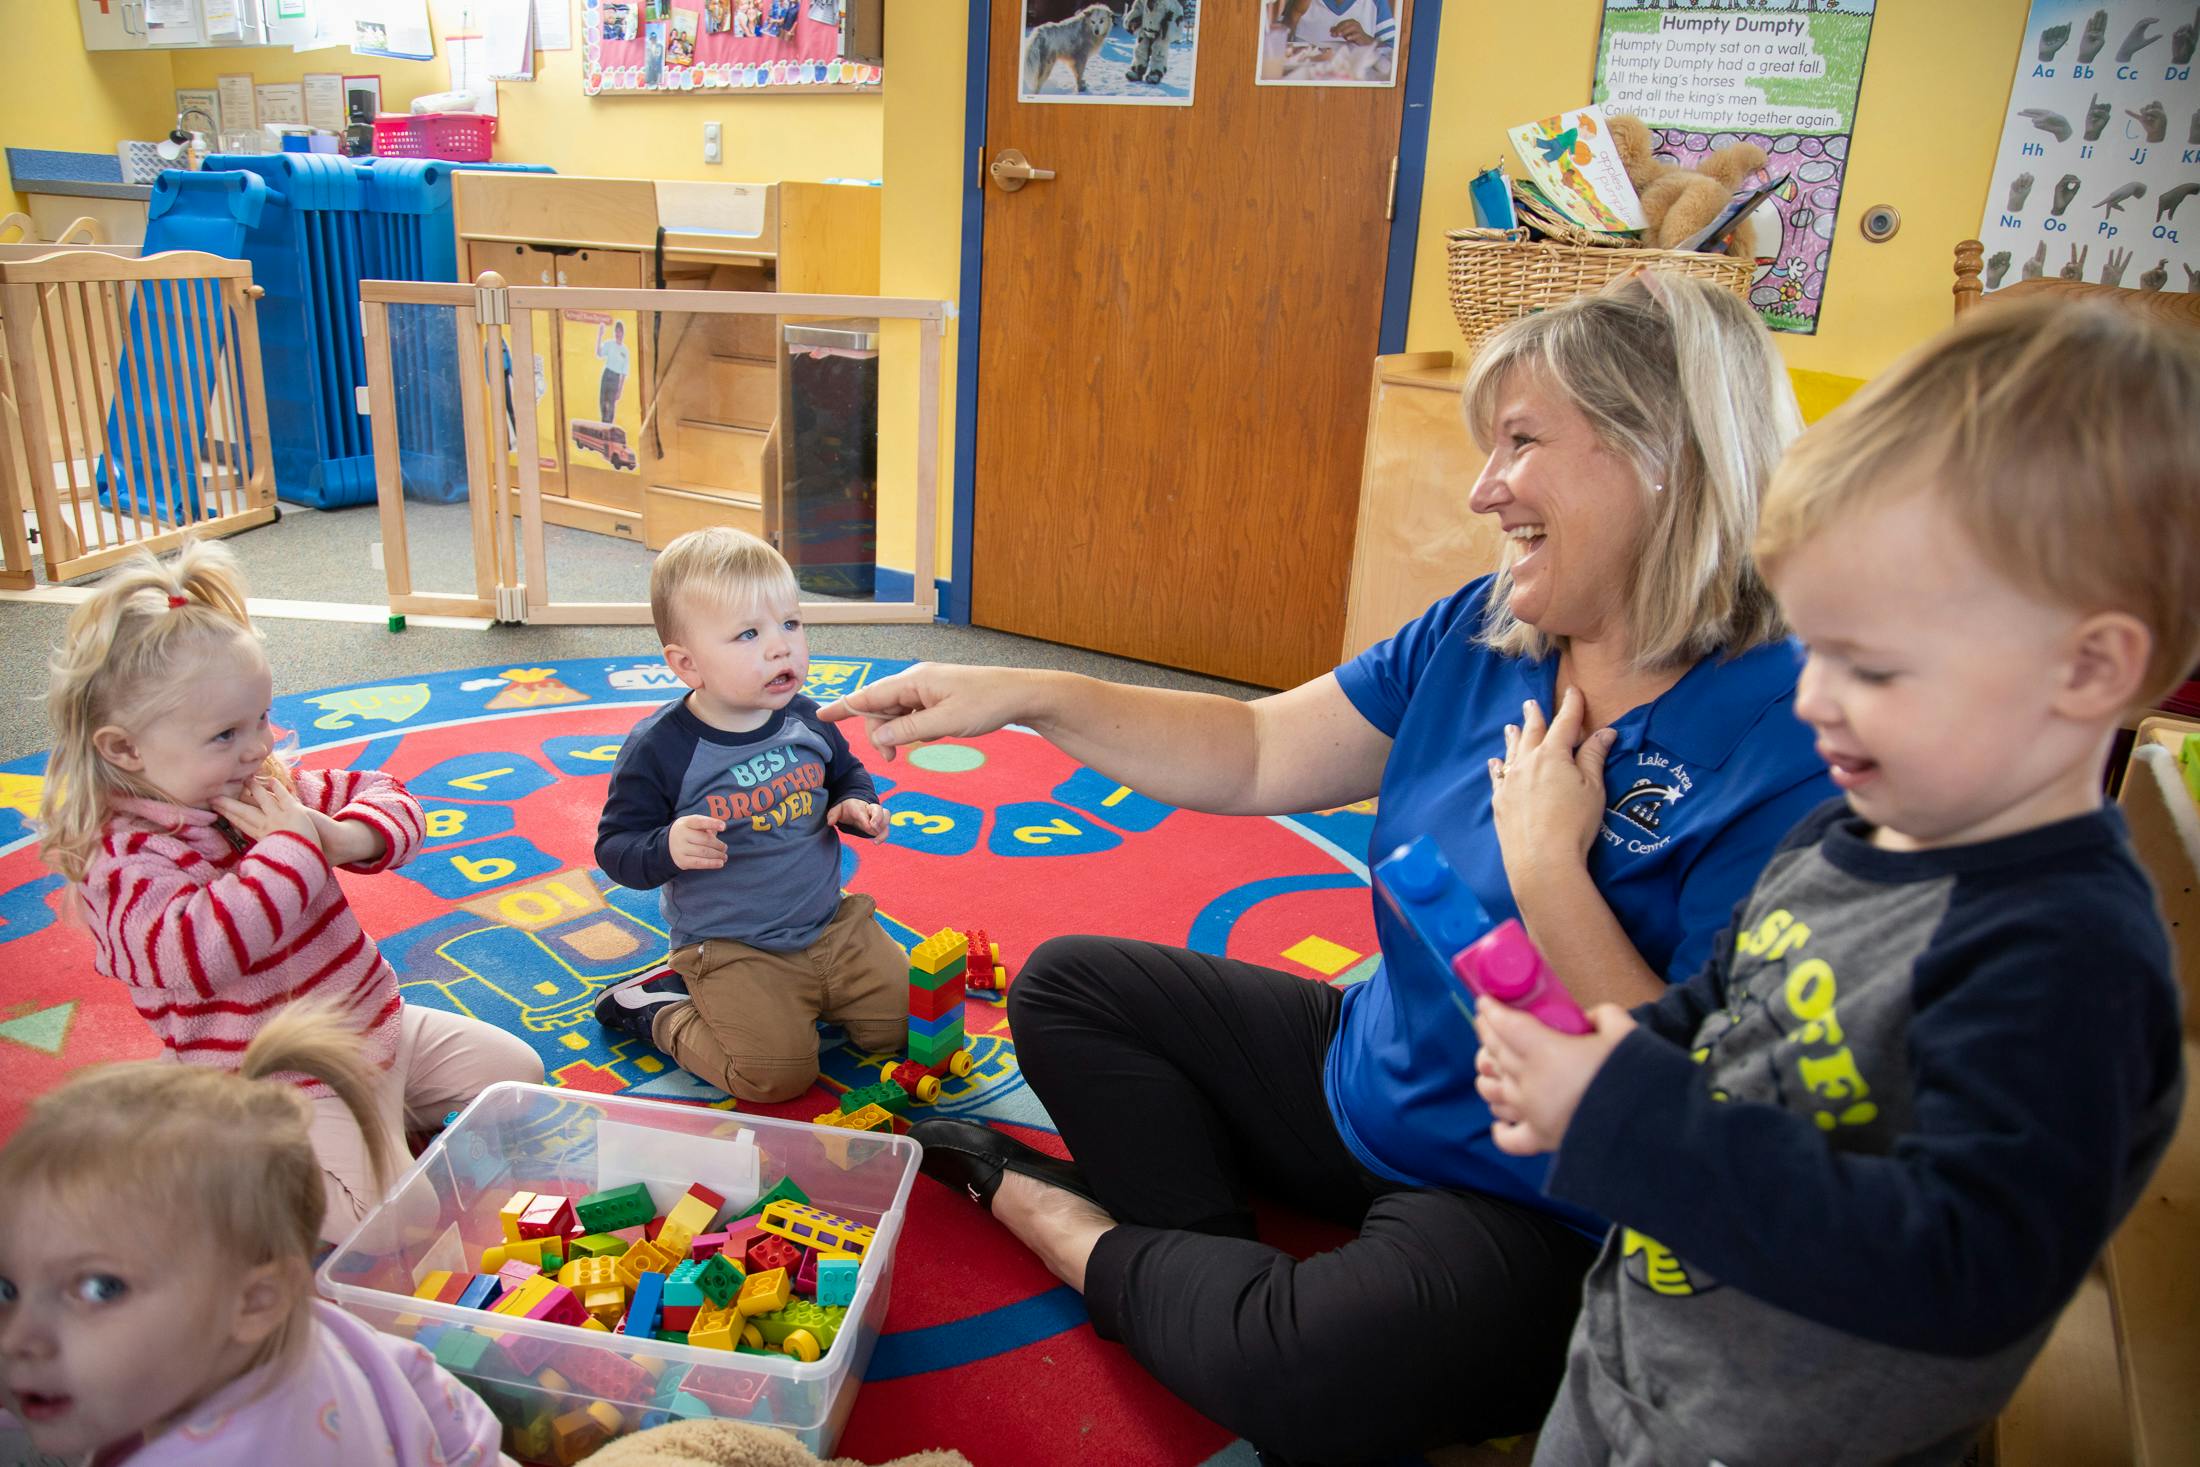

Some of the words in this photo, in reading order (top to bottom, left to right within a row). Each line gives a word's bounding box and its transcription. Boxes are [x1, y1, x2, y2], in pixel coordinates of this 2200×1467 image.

[1663, 15, 1730, 35] Humpty
[1735, 17, 1805, 37] Dumpty
[1613, 38, 1662, 54] Humpty
[1666, 40, 1716, 55] Dumpty
[1720, 42, 1740, 53] sat
[1744, 44, 1760, 54] on
[1764, 45, 1774, 54] a
[1778, 42, 1808, 57] wall,
[1611, 55, 1660, 70] Humpty
[1664, 57, 1714, 72] Dumpty
[1717, 58, 1743, 71] had
[1747, 61, 1756, 71] a
[1760, 61, 1795, 75] great
[1799, 60, 1822, 74] fall.
[2032, 64, 2055, 78] Aa
[2073, 65, 2094, 79] Bb
[2116, 66, 2138, 80] Cc
[2165, 66, 2190, 81] Dd
[1608, 71, 1625, 83] All
[1629, 72, 1648, 84] the
[1652, 73, 1688, 88] king's
[1692, 74, 1735, 87] horses
[1618, 89, 1642, 101] and
[1646, 89, 1661, 101] all
[1665, 90, 1685, 102] the
[1688, 91, 1724, 107] king's
[1728, 95, 1757, 105] men
[1659, 108, 1680, 121] put
[1683, 108, 1735, 124] Humpty
[1737, 110, 1792, 126] together
[1796, 114, 1837, 129] again.
[2022, 143, 2044, 156] Hh
[2080, 146, 2093, 159] Ii
[2129, 148, 2147, 165] Jj
[2000, 215, 2022, 229] Nn
[2044, 218, 2067, 232] Oo
[2098, 222, 2118, 239] Pp
[2152, 225, 2179, 243] Qq
[729, 744, 799, 787] BEST
[1637, 752, 1669, 768] Lake
[1669, 763, 1693, 792] Area
[1013, 818, 1083, 844] 2
[1628, 835, 1671, 855] Center
